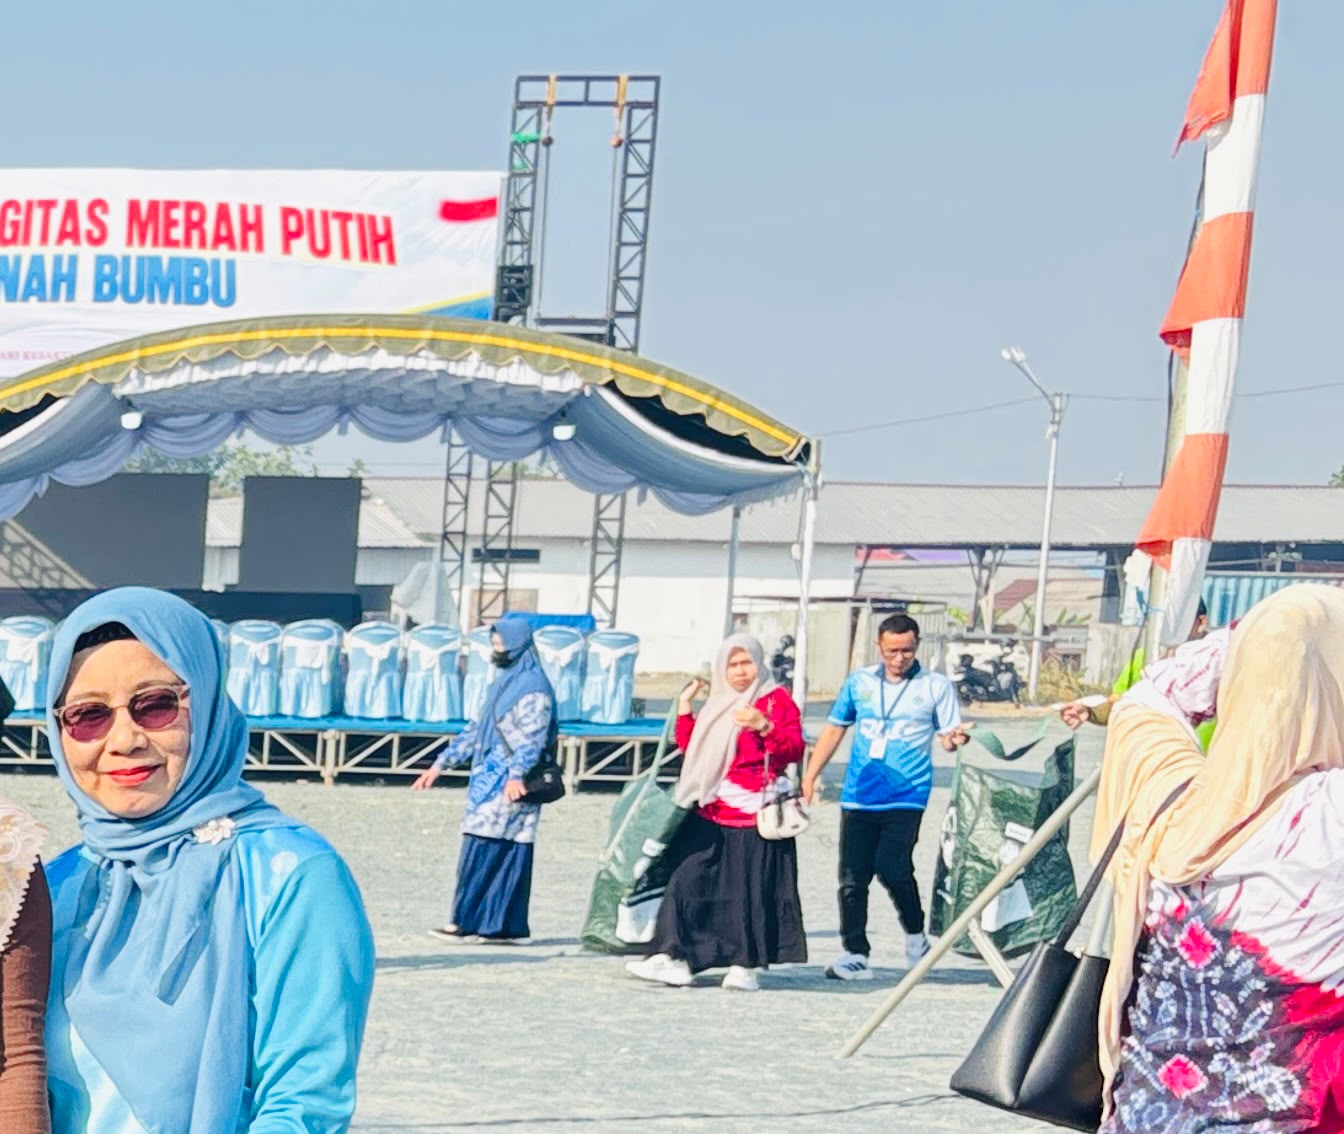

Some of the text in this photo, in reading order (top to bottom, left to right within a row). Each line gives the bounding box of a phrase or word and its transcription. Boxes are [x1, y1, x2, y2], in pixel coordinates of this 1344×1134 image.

[125, 199, 265, 253] MERAH
[279, 206, 397, 266] PUTIH
[92, 254, 237, 308] BUMBU
